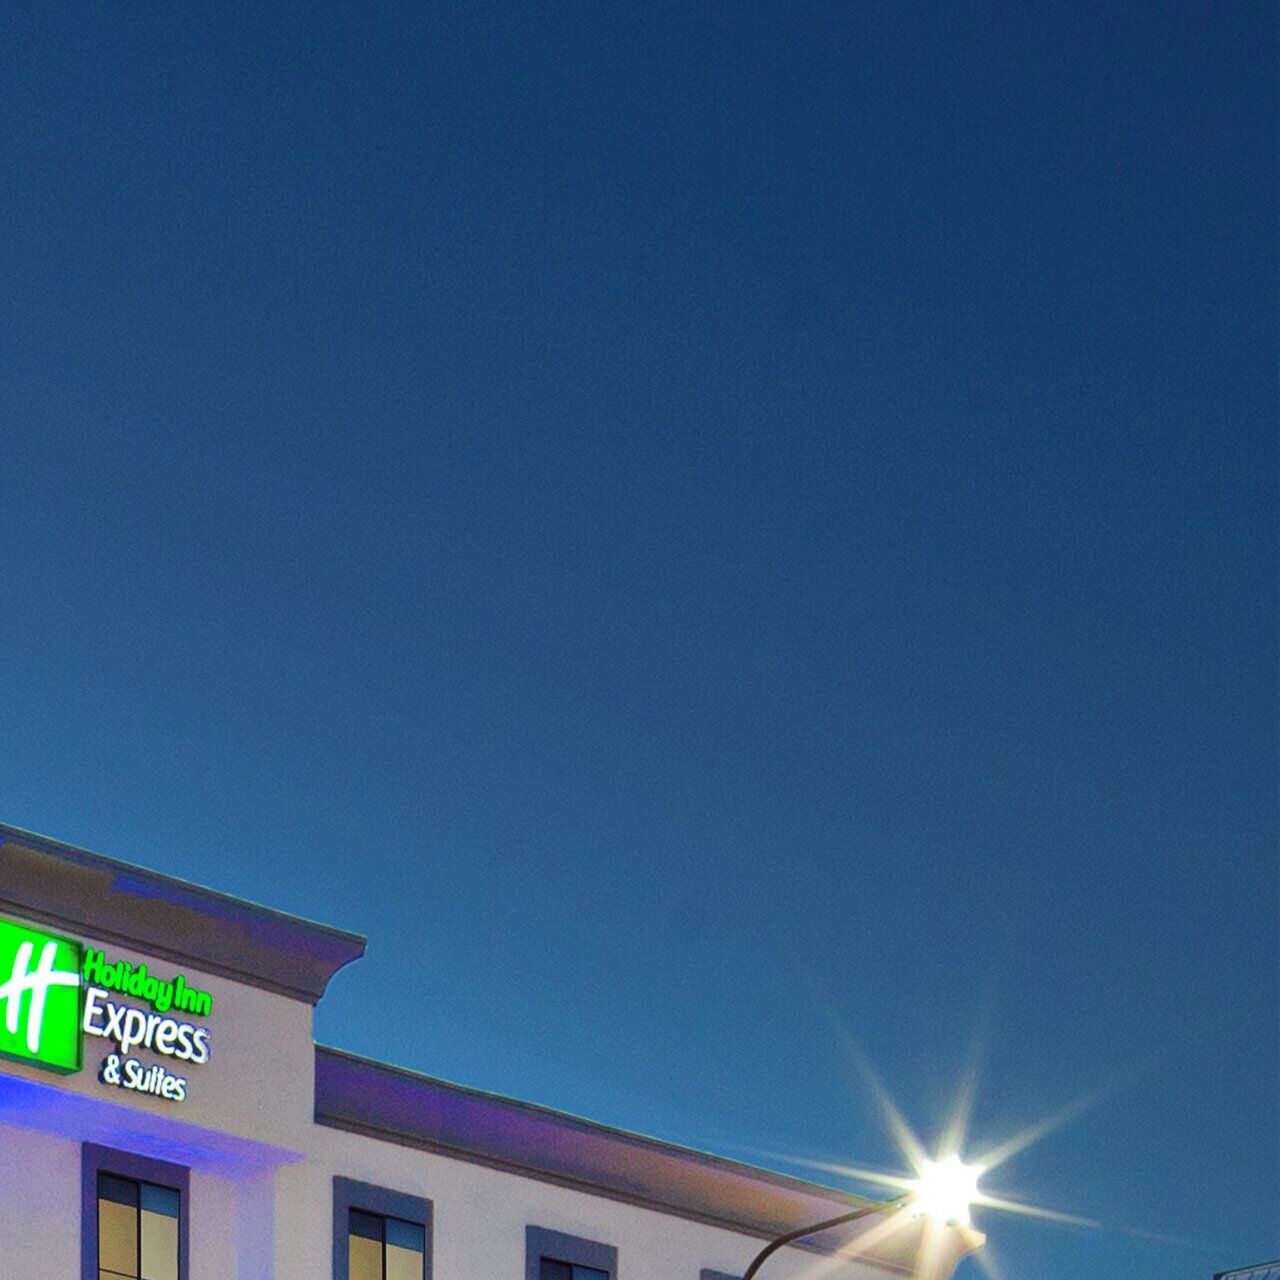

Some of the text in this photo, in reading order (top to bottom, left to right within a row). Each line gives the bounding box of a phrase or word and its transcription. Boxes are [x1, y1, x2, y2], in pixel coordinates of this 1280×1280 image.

[82, 949, 212, 1016] Holiday Inn
[83, 988, 211, 1064] Express
[103, 1055, 186, 1102] & Suites
